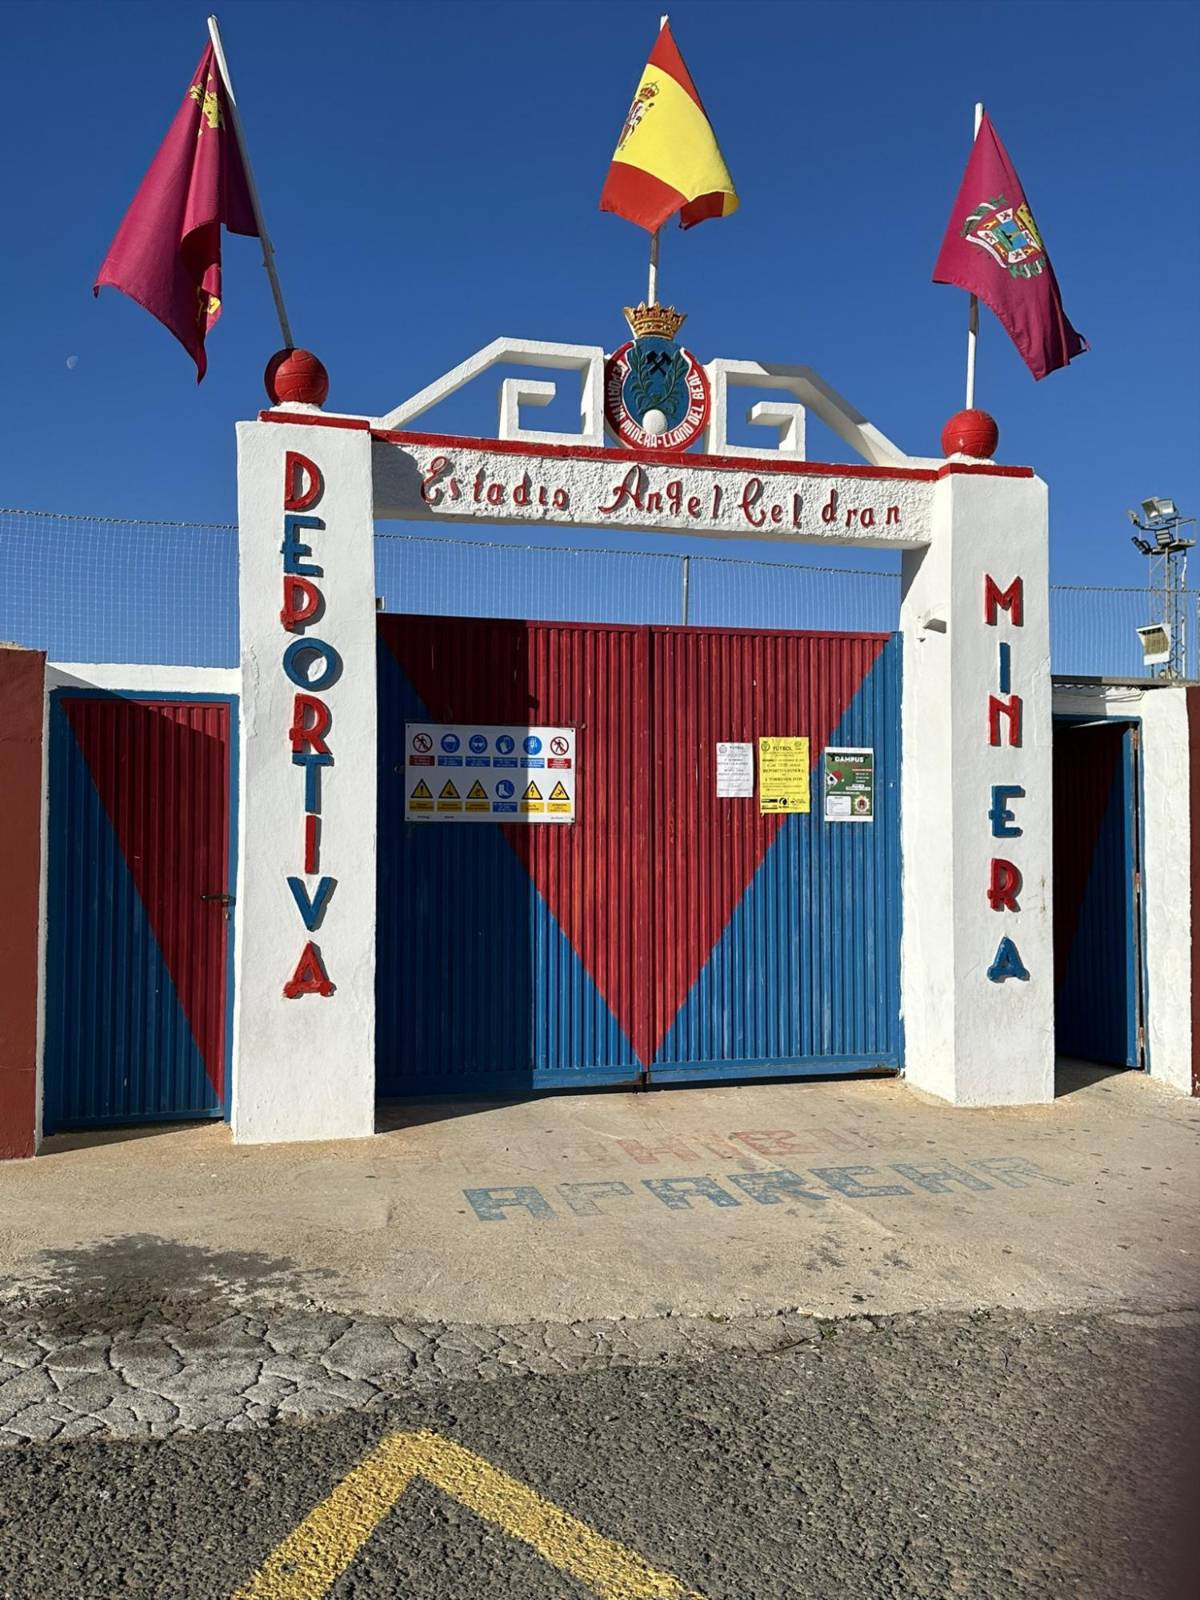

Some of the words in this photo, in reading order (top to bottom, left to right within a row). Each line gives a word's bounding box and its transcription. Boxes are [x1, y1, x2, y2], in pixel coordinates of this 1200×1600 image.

[688, 369, 705, 400] BEAL
[620, 420, 657, 448] MINERA
[662, 423, 694, 448] LLANO
[687, 405, 704, 429] DEL
[420, 456, 570, 509] Estadio
[599, 465, 720, 519] Angel
[280, 450, 339, 999] DEPORTIVA
[983, 573, 1028, 983] MINERA
[462, 1156, 1075, 1220] APARCAR
